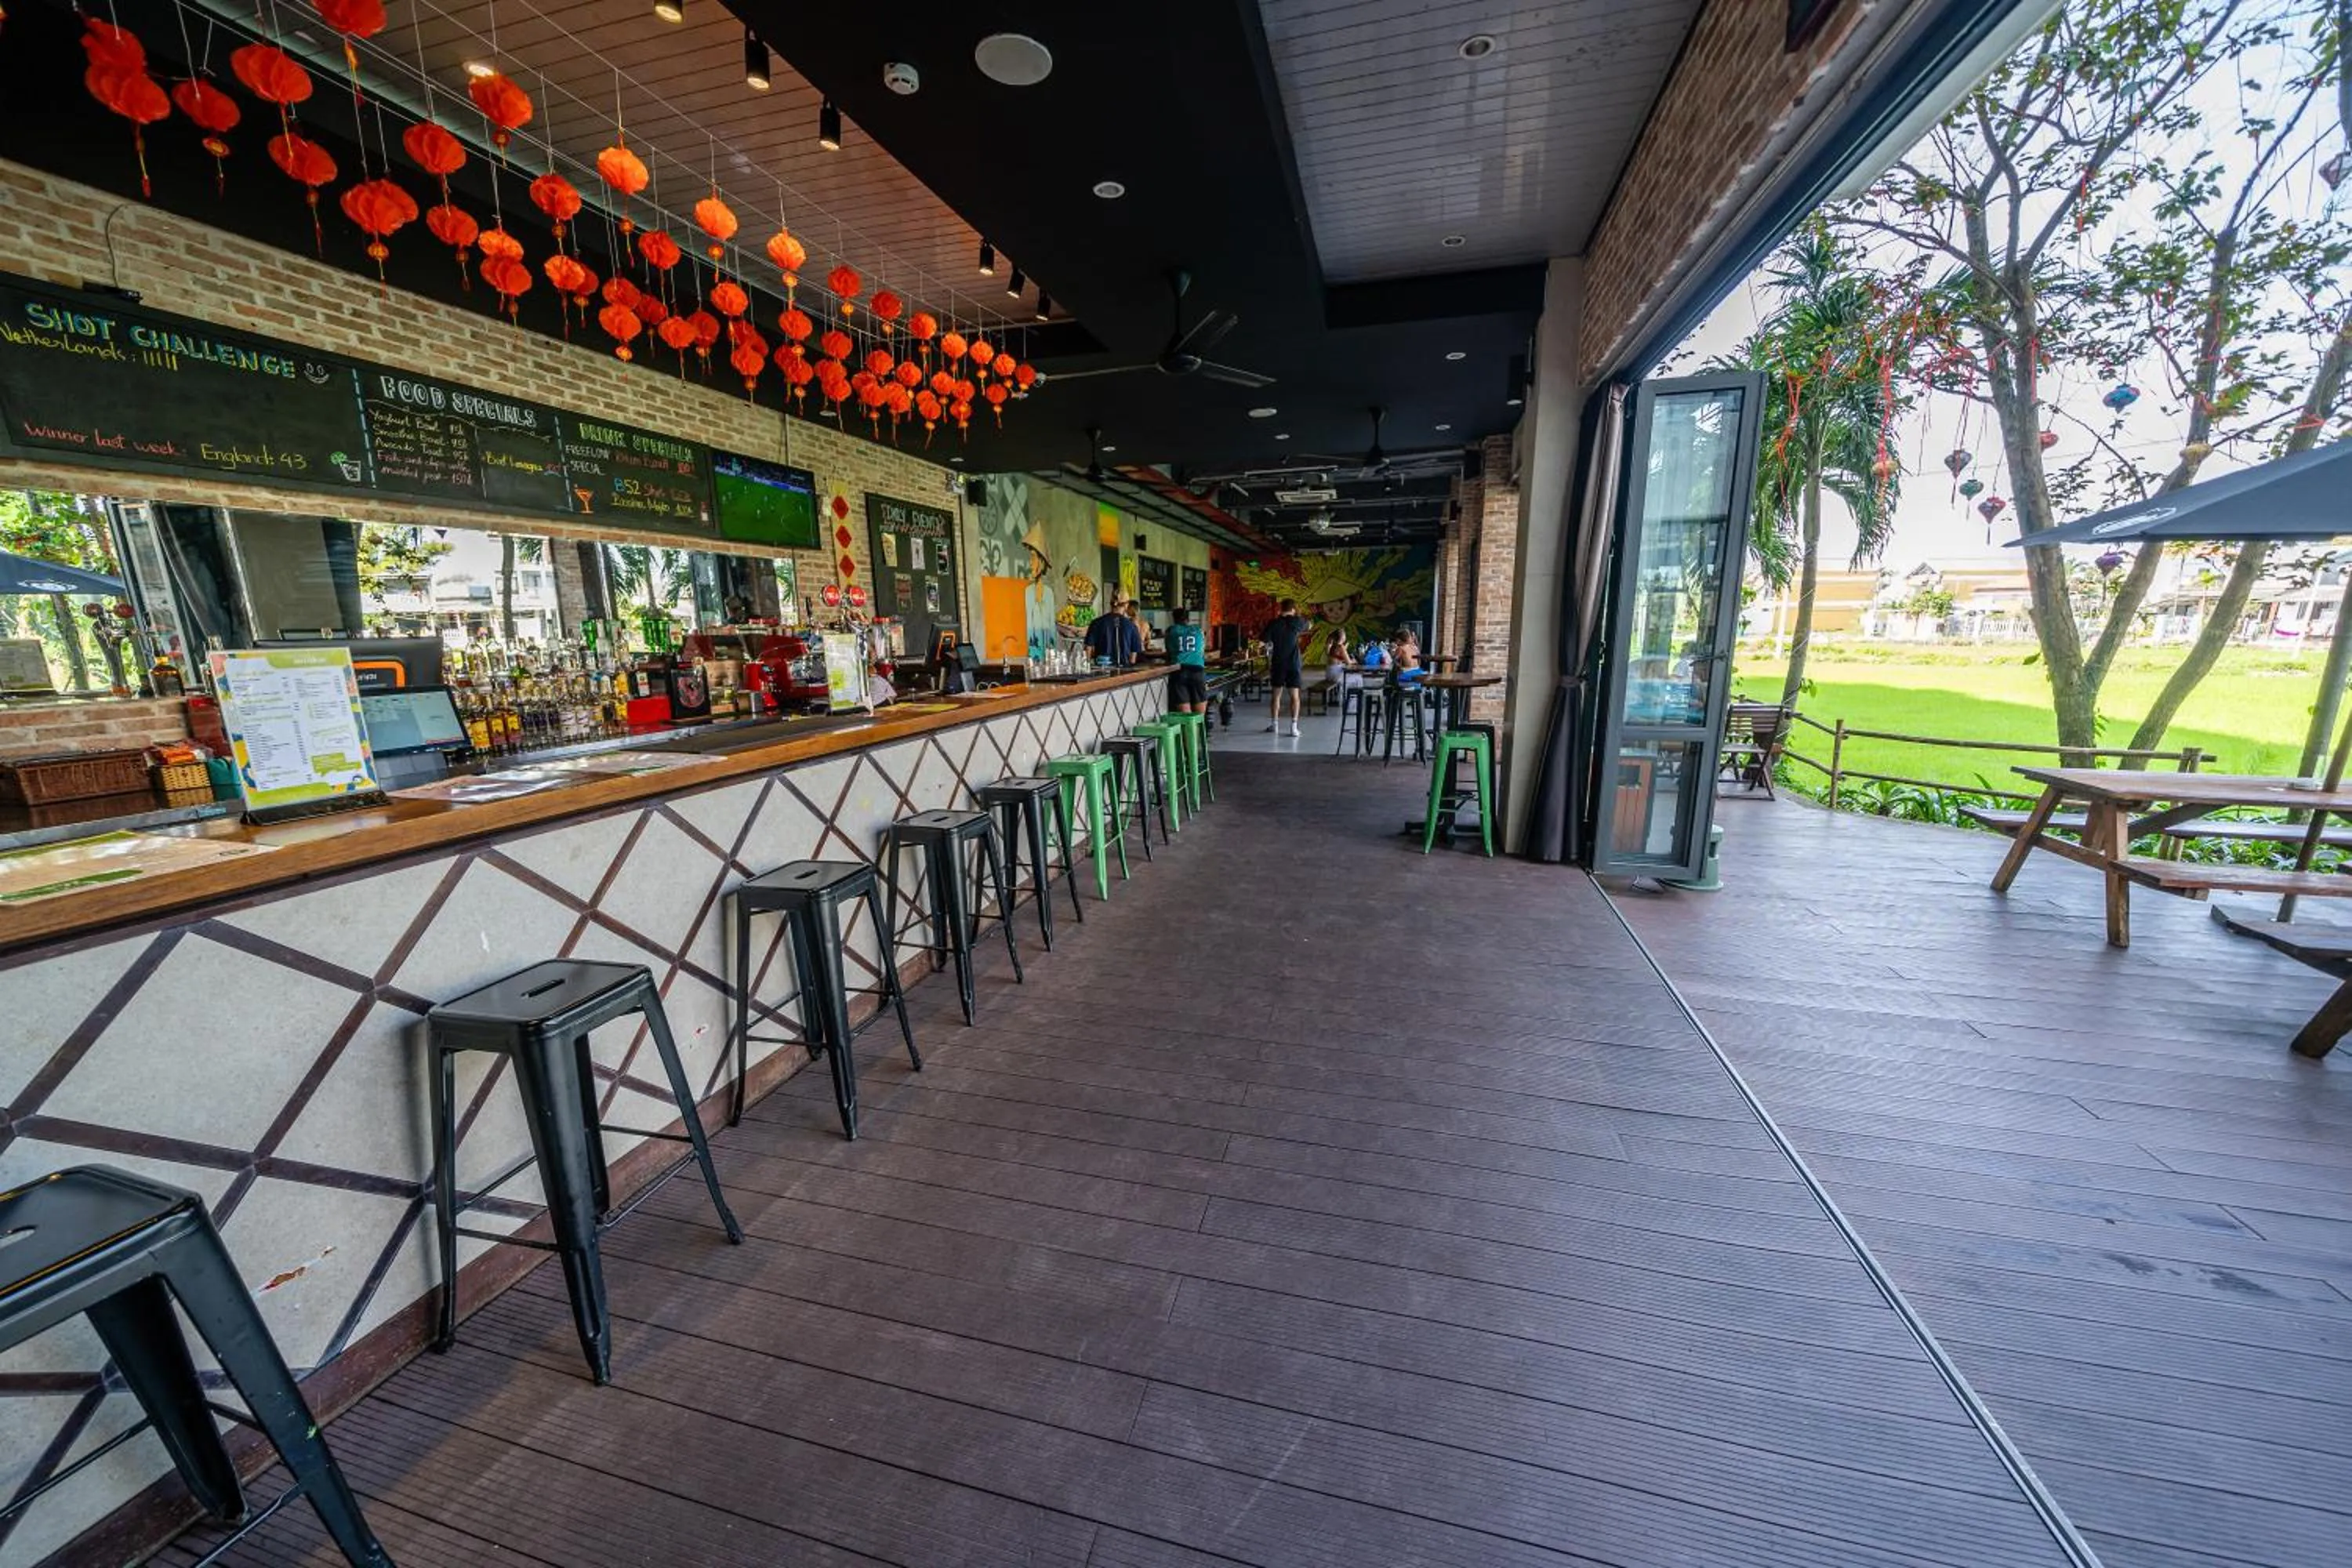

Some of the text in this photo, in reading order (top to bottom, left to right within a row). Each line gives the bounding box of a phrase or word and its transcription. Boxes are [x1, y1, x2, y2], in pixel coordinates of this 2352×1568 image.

[25, 302, 296, 379] SHOT CHALLENGE
[379, 375, 537, 428] FOOD SPECIALS
[95, 428, 126, 450] last
[614, 477, 642, 496] B52
[1178, 636, 1196, 652] 12
